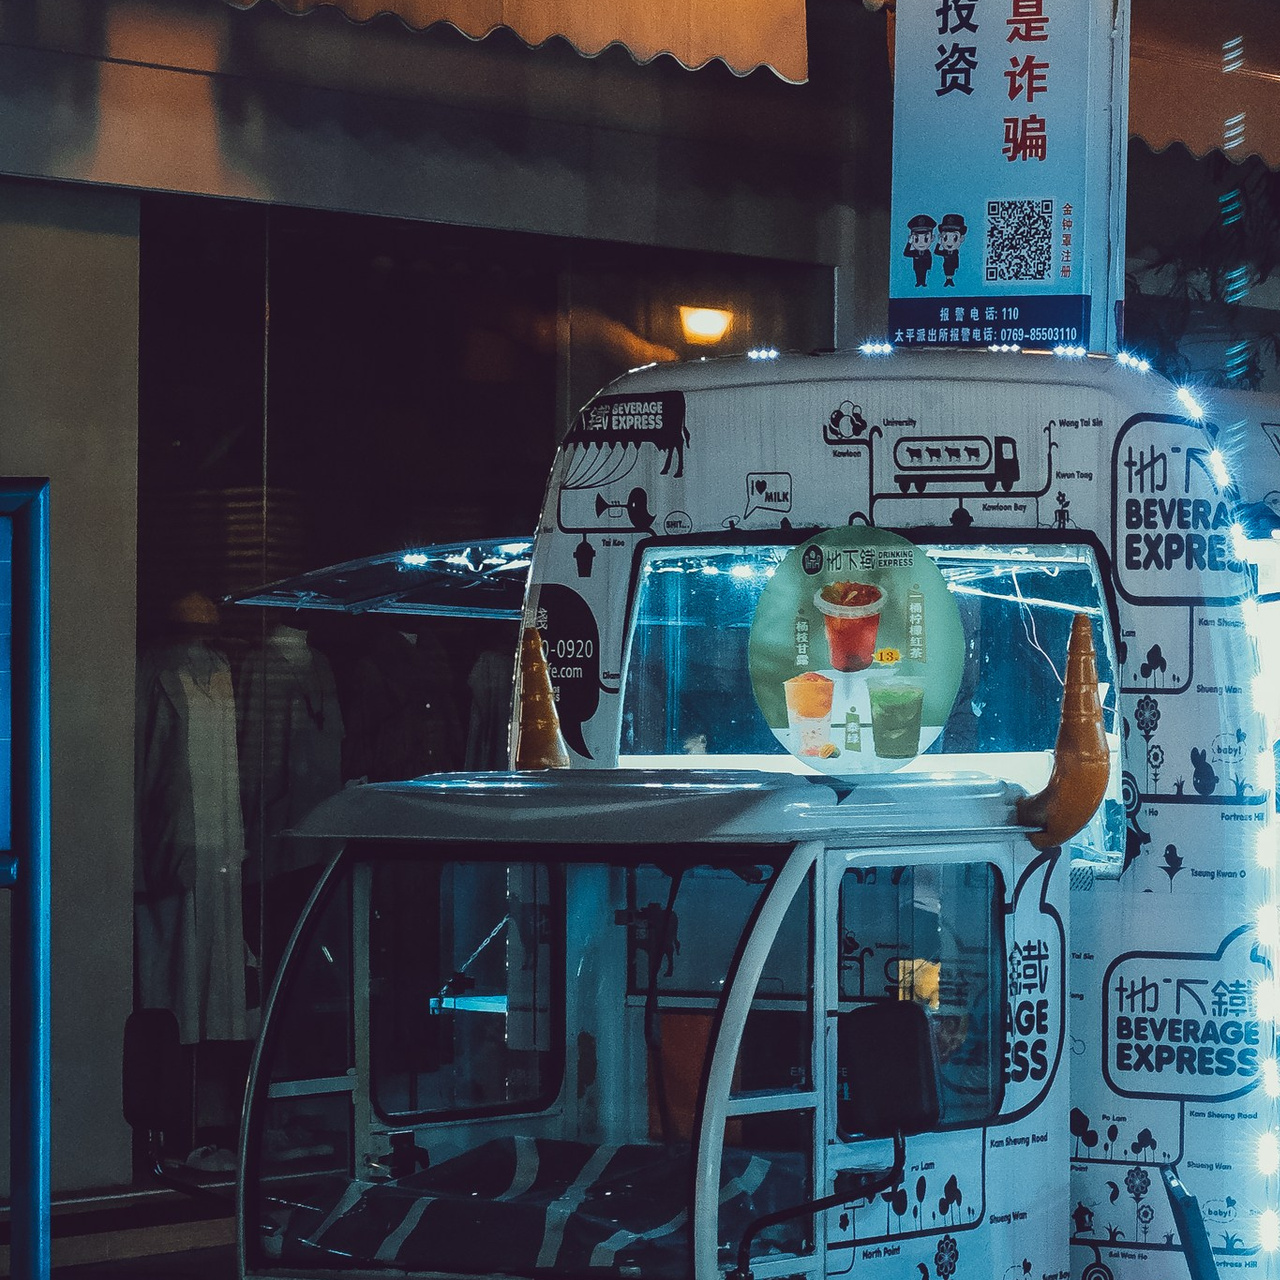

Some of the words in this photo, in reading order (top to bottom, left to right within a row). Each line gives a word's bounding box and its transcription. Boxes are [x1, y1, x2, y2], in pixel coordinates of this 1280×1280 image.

[612, 402, 663, 415] BEVERAGE
[612, 414, 663, 430] EXPRESS
[764, 491, 789, 503] MILK
[1125, 498, 1232, 530] BEVERA
[878, 550, 914, 559] DRINKING
[1125, 533, 1243, 571] EXPRE
[878, 558, 914, 568] EXPRESS
[1216, 744, 1242, 756] baby!
[1116, 1016, 1260, 1045] BEVERAGE
[1116, 1043, 1259, 1076] EXPRESS
[1207, 1206, 1232, 1218] baby!
[1216, 1261, 1243, 1269] ortress
